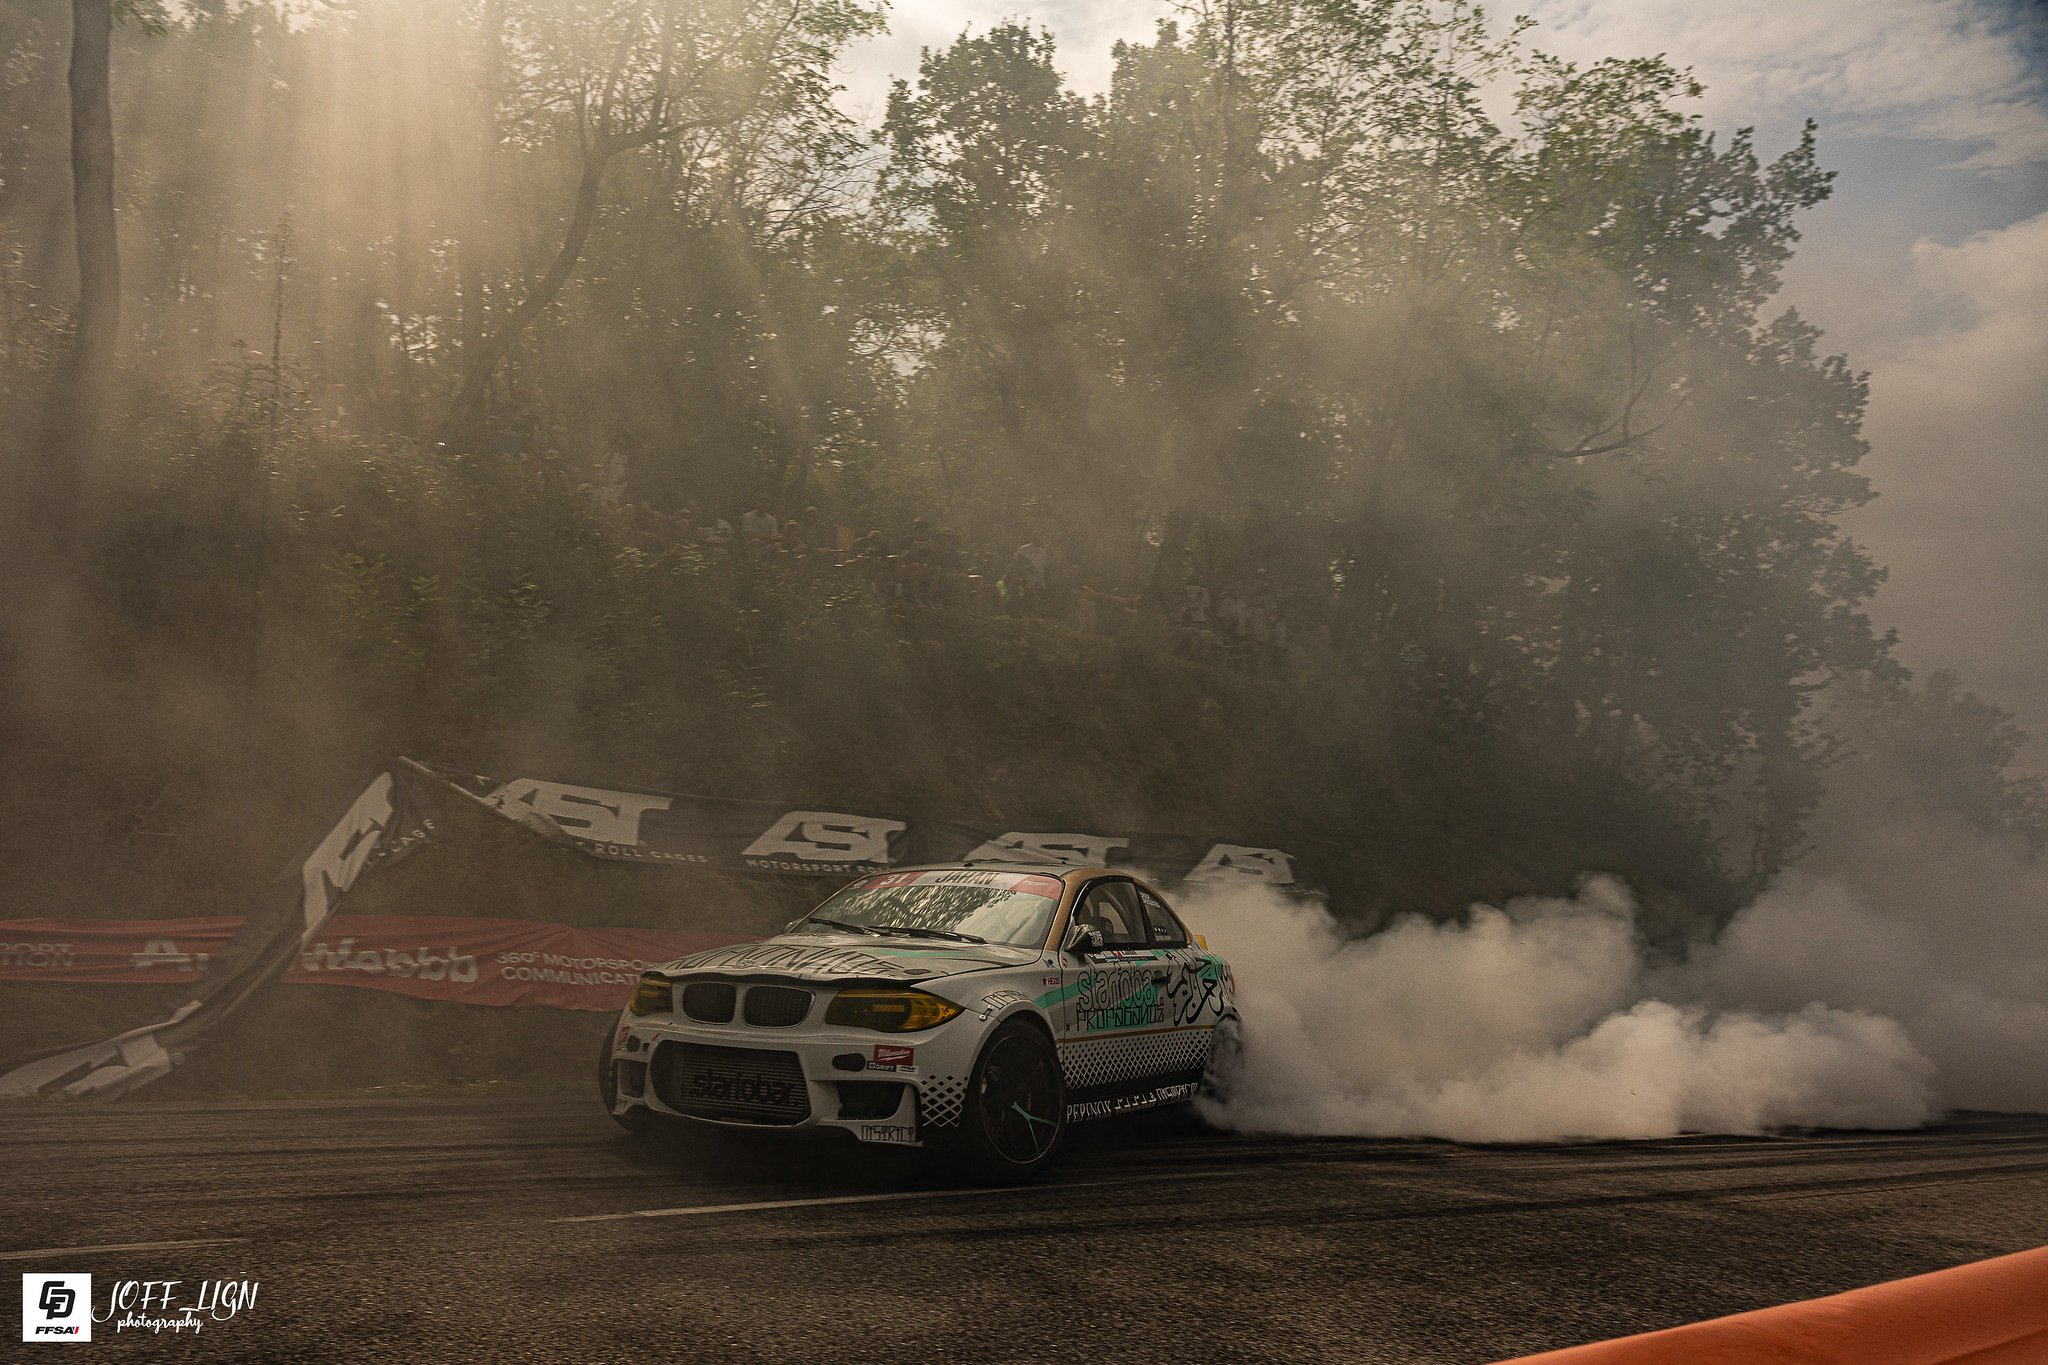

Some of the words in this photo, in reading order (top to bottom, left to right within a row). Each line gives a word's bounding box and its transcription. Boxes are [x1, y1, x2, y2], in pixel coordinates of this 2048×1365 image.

[741, 811, 907, 863] AST
[745, 858, 852, 874] MOTORSPORT
[881, 874, 911, 887] 31
[934, 871, 1000, 886] JAHAN
